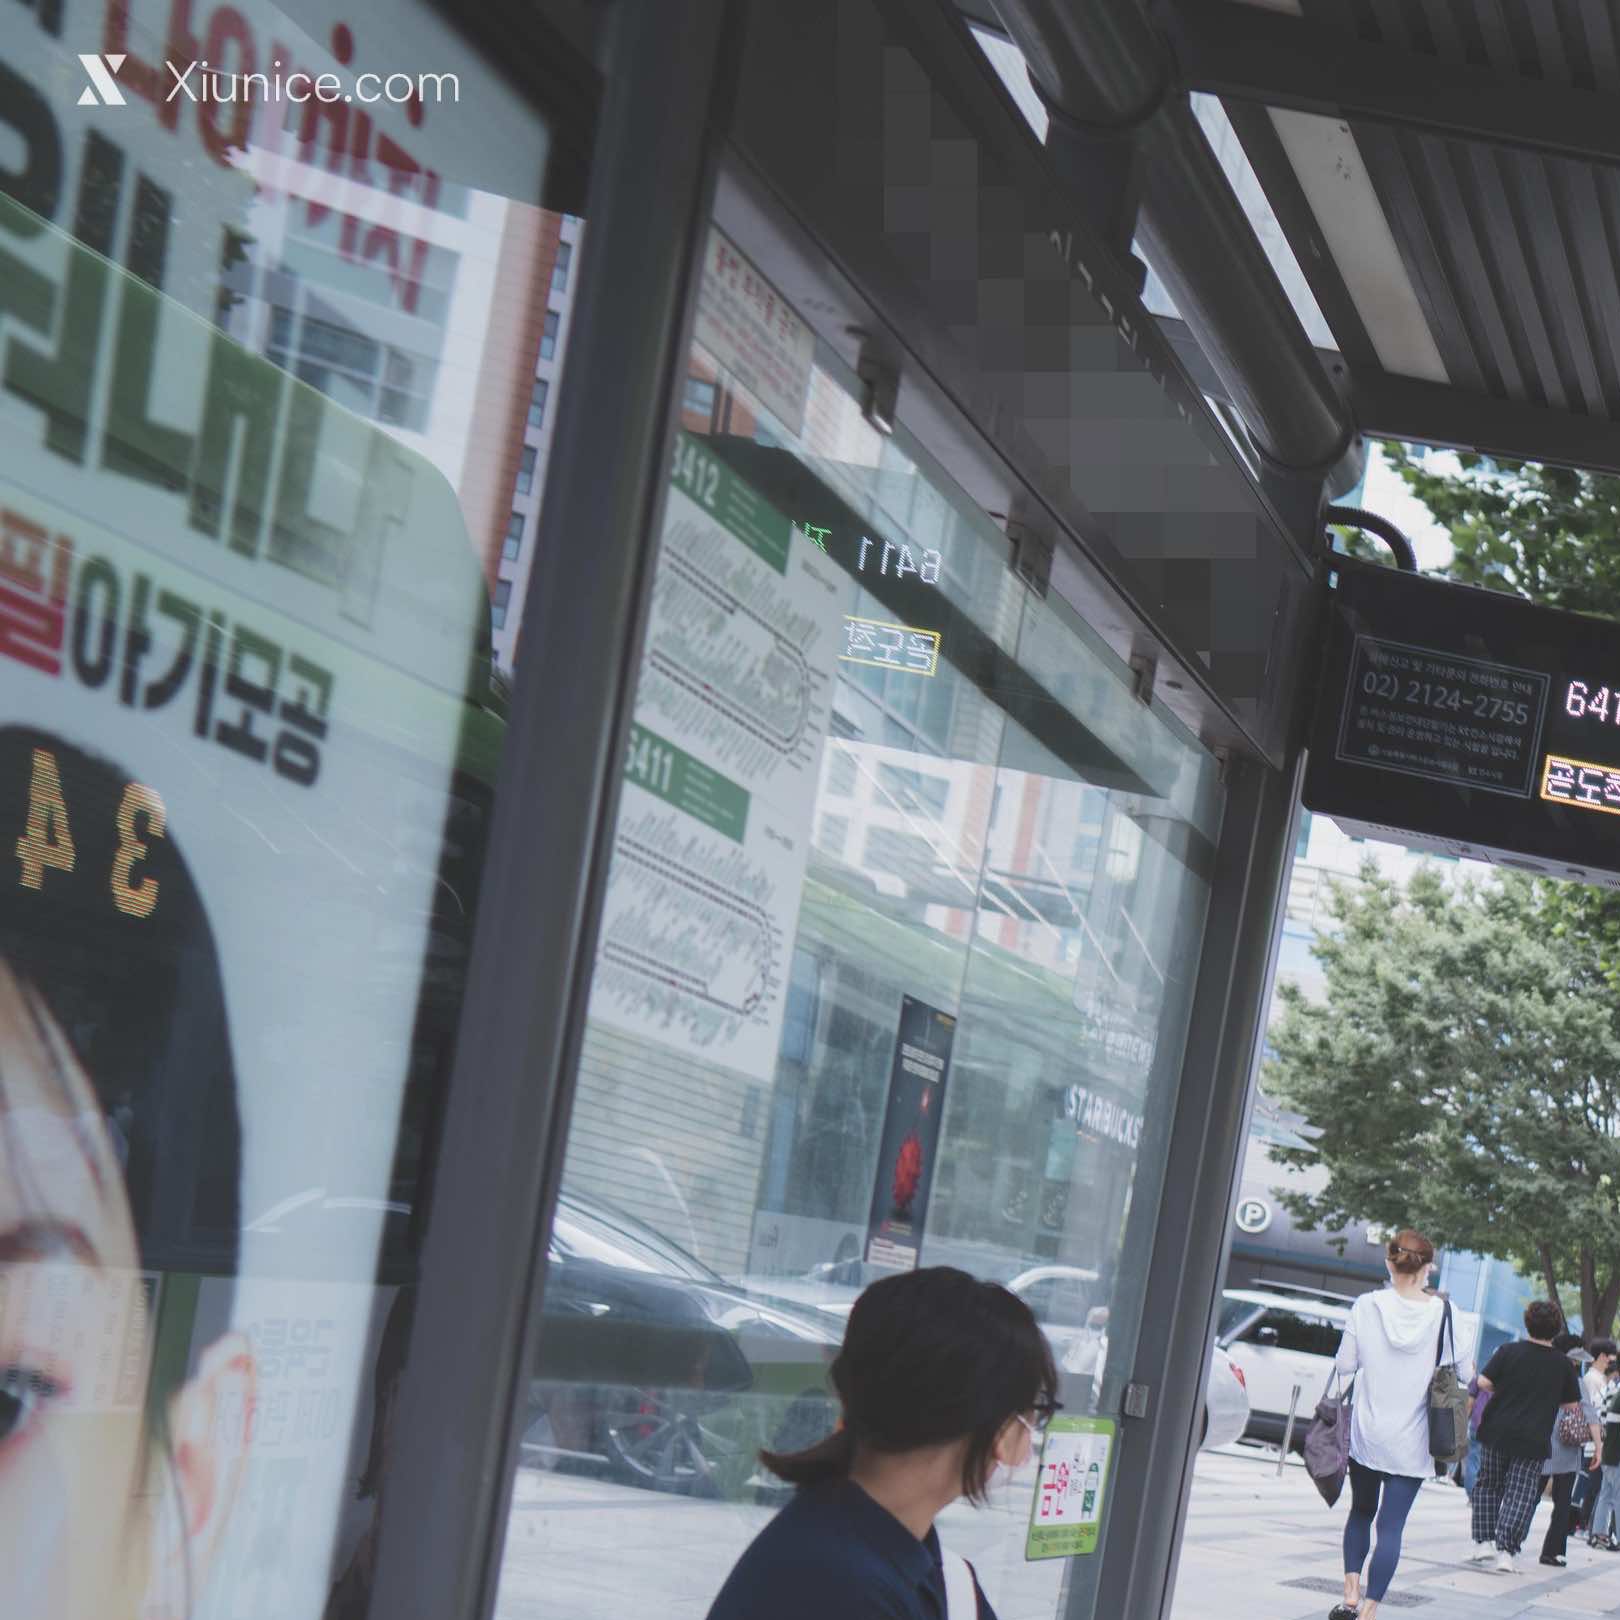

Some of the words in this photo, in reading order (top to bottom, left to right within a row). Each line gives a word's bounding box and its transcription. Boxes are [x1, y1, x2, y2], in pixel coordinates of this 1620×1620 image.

[1361, 669, 1400, 701] 02)
[1405, 679, 1529, 726] 2124-2755
[1065, 1083, 1144, 1149] STARBUCKS
